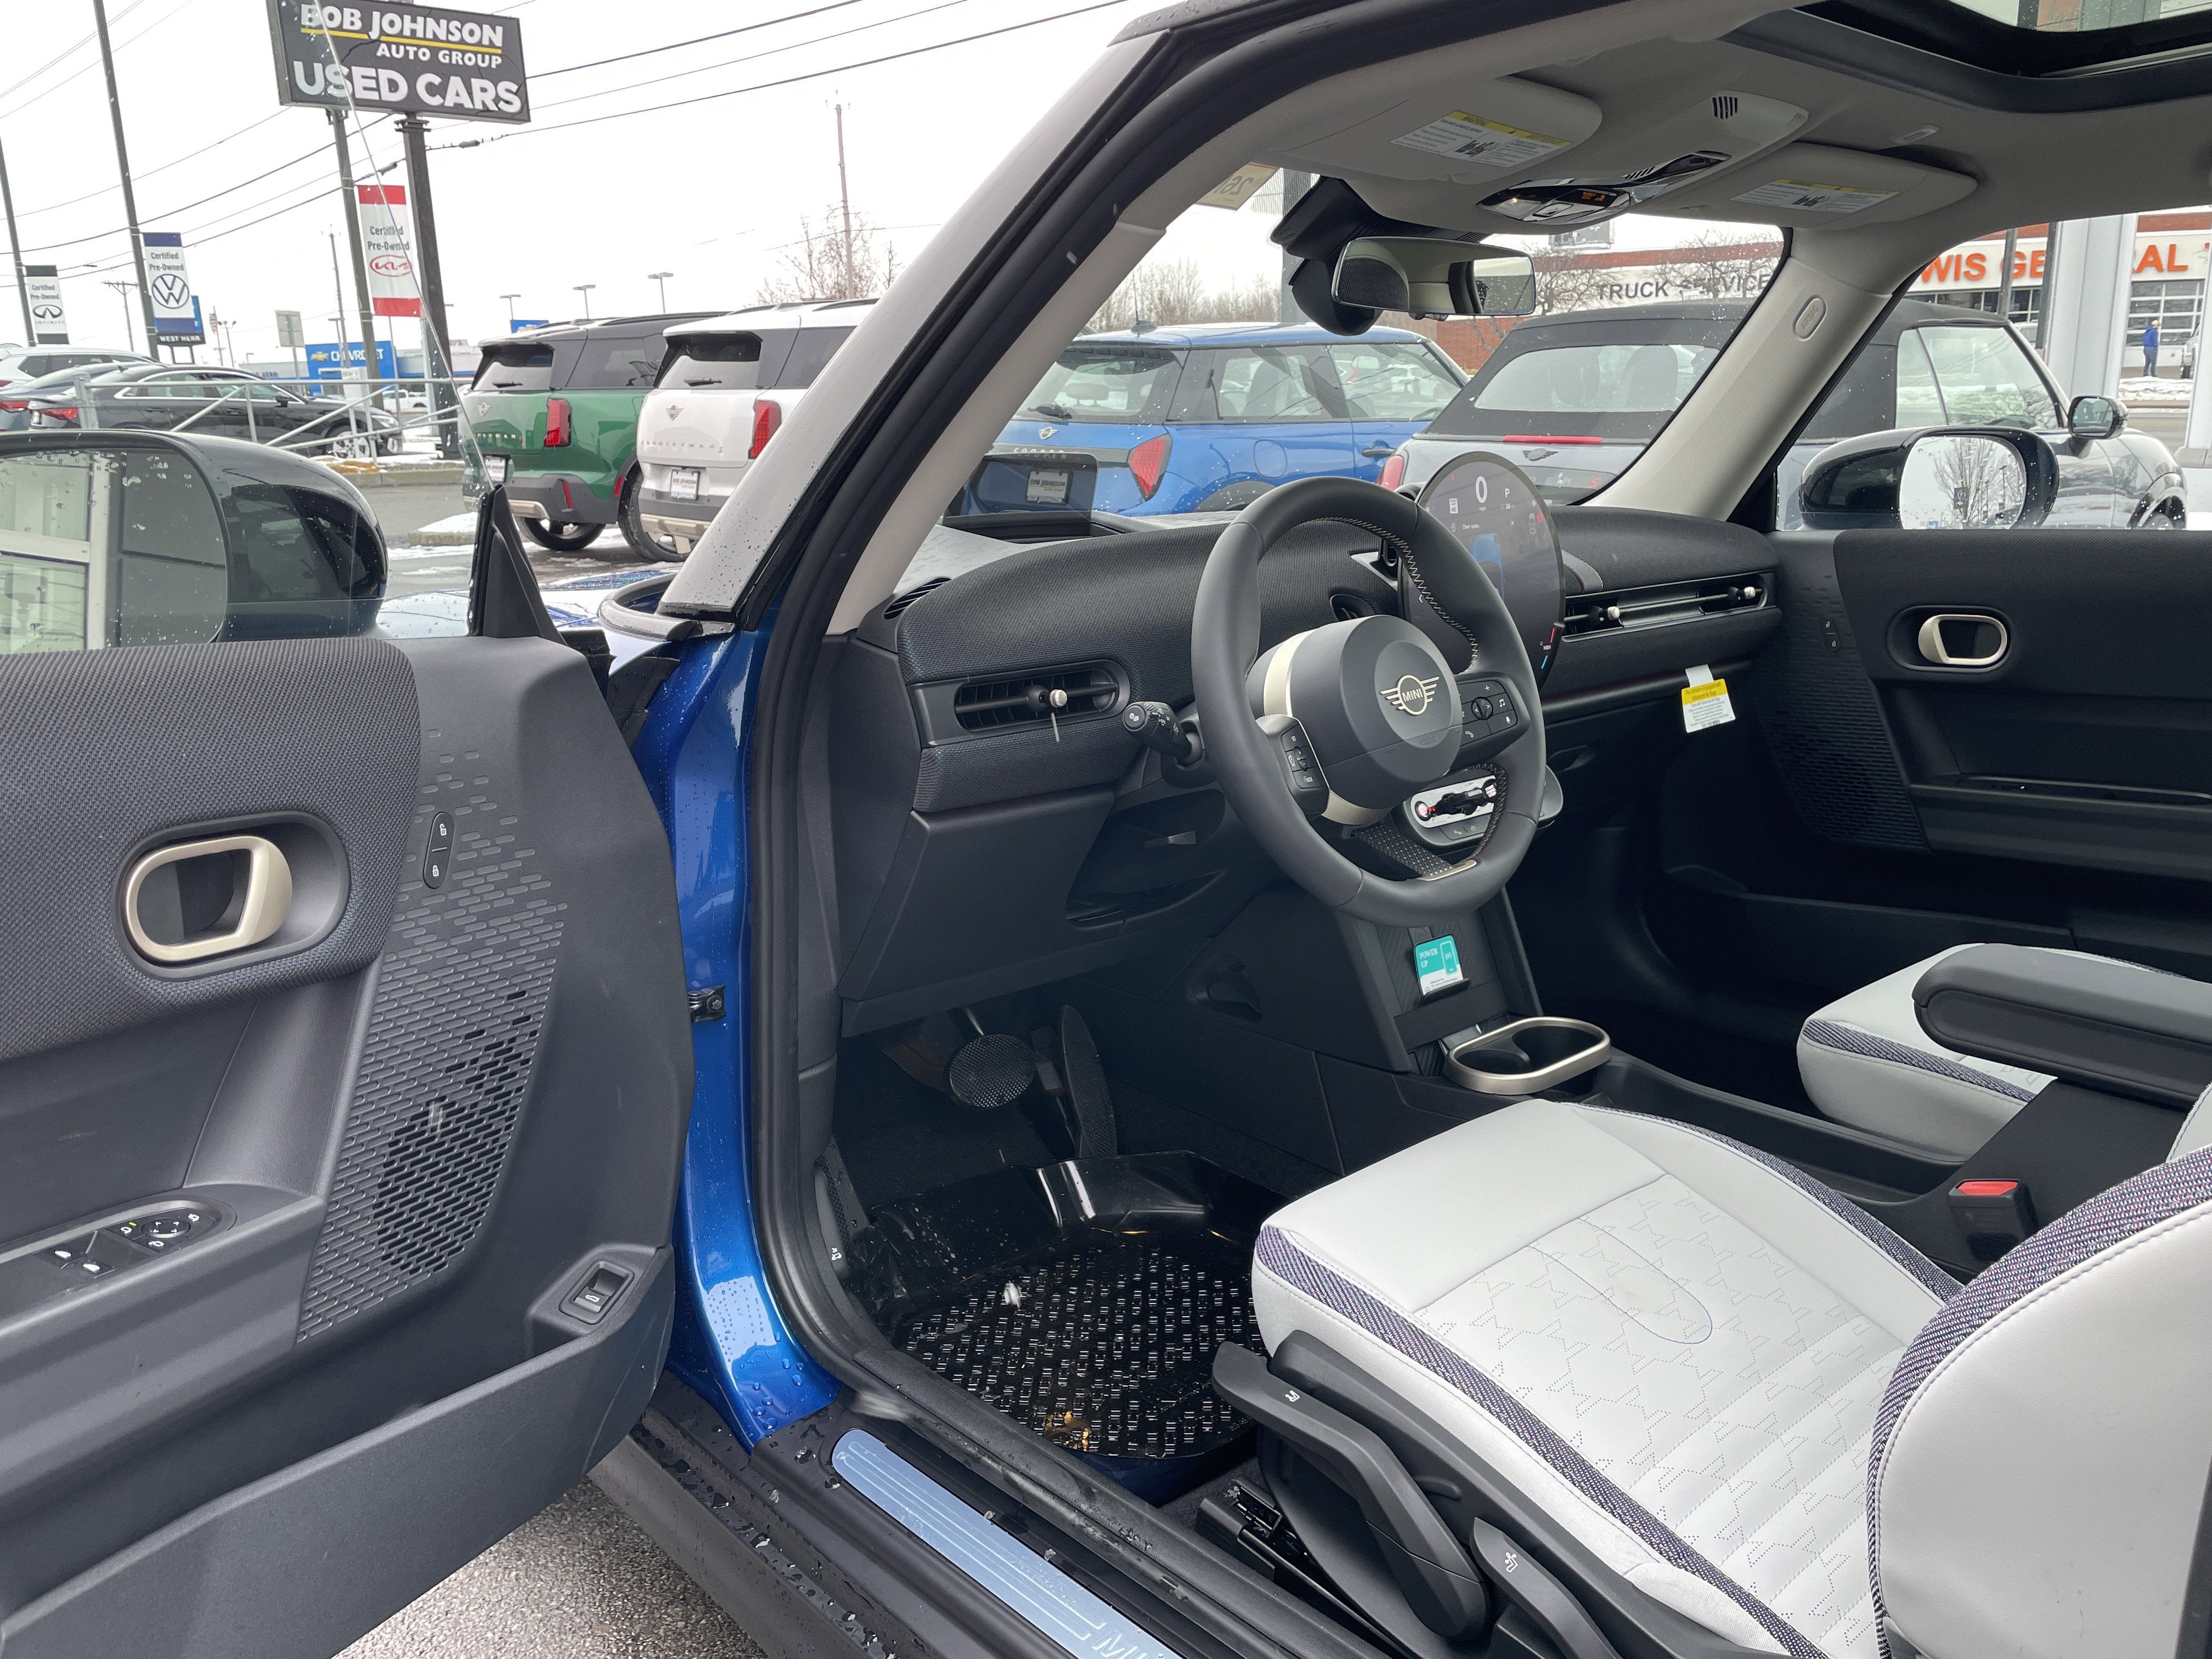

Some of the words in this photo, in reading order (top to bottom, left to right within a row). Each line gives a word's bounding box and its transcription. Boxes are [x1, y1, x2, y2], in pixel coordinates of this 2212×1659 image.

[301, 4, 362, 31] BOB
[368, 10, 503, 47] JOHNSON
[376, 42, 431, 61] AUTO
[438, 50, 502, 69] GROUP
[294, 60, 408, 102] USED
[416, 72, 522, 113] CARS
[368, 241, 410, 251] Pre-Owd
[1598, 281, 1669, 300] TRUCK
[1801, 306, 1818, 330] AIRBAG
[1475, 476, 1488, 504] 0
[1505, 488, 1510, 498] P
[1402, 688, 1423, 702] MINI
[1419, 947, 1438, 960] POWER
